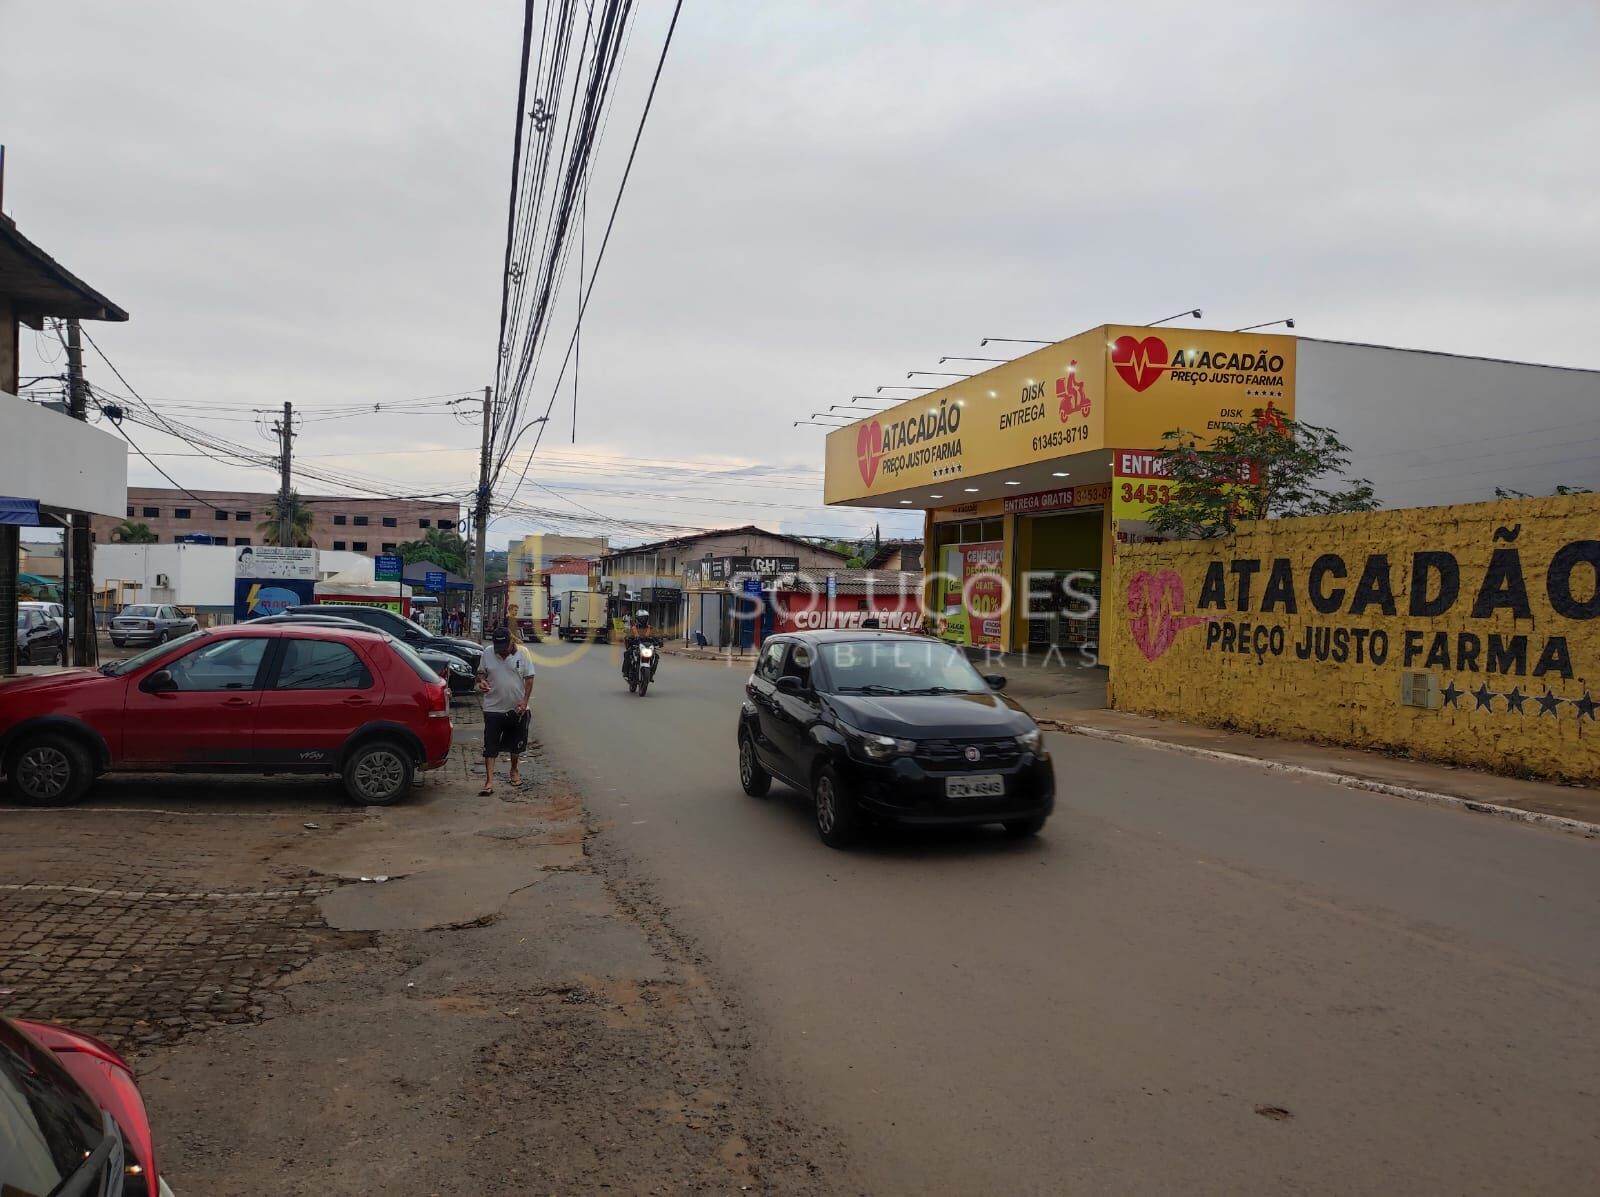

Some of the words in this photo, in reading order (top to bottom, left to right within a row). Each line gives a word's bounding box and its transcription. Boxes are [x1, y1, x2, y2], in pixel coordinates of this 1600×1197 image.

[1171, 349, 1284, 373] ATACADÃO
[1022, 381, 1046, 404] DISK
[1170, 371, 1208, 386] PREÇO
[1209, 373, 1245, 384] JUSTO
[1245, 375, 1284, 387] FARMA
[882, 398, 961, 453] ATACADÃO
[1000, 403, 1046, 431] ENTREGA
[1220, 408, 1243, 418] DISK
[1032, 424, 1089, 452] 613453-8719
[882, 455, 906, 477] PREÇO
[905, 448, 931, 469] JUSTO
[931, 438, 962, 462] FARMA
[1004, 496, 1040, 512] ENTREGA
[1041, 491, 1073, 506] GRATIS
[1197, 523, 1600, 620] ATACADÃO
[1207, 621, 1285, 665] PREÇO
[1296, 623, 1389, 666] JUSTO
[1403, 631, 1574, 679] FARMA
